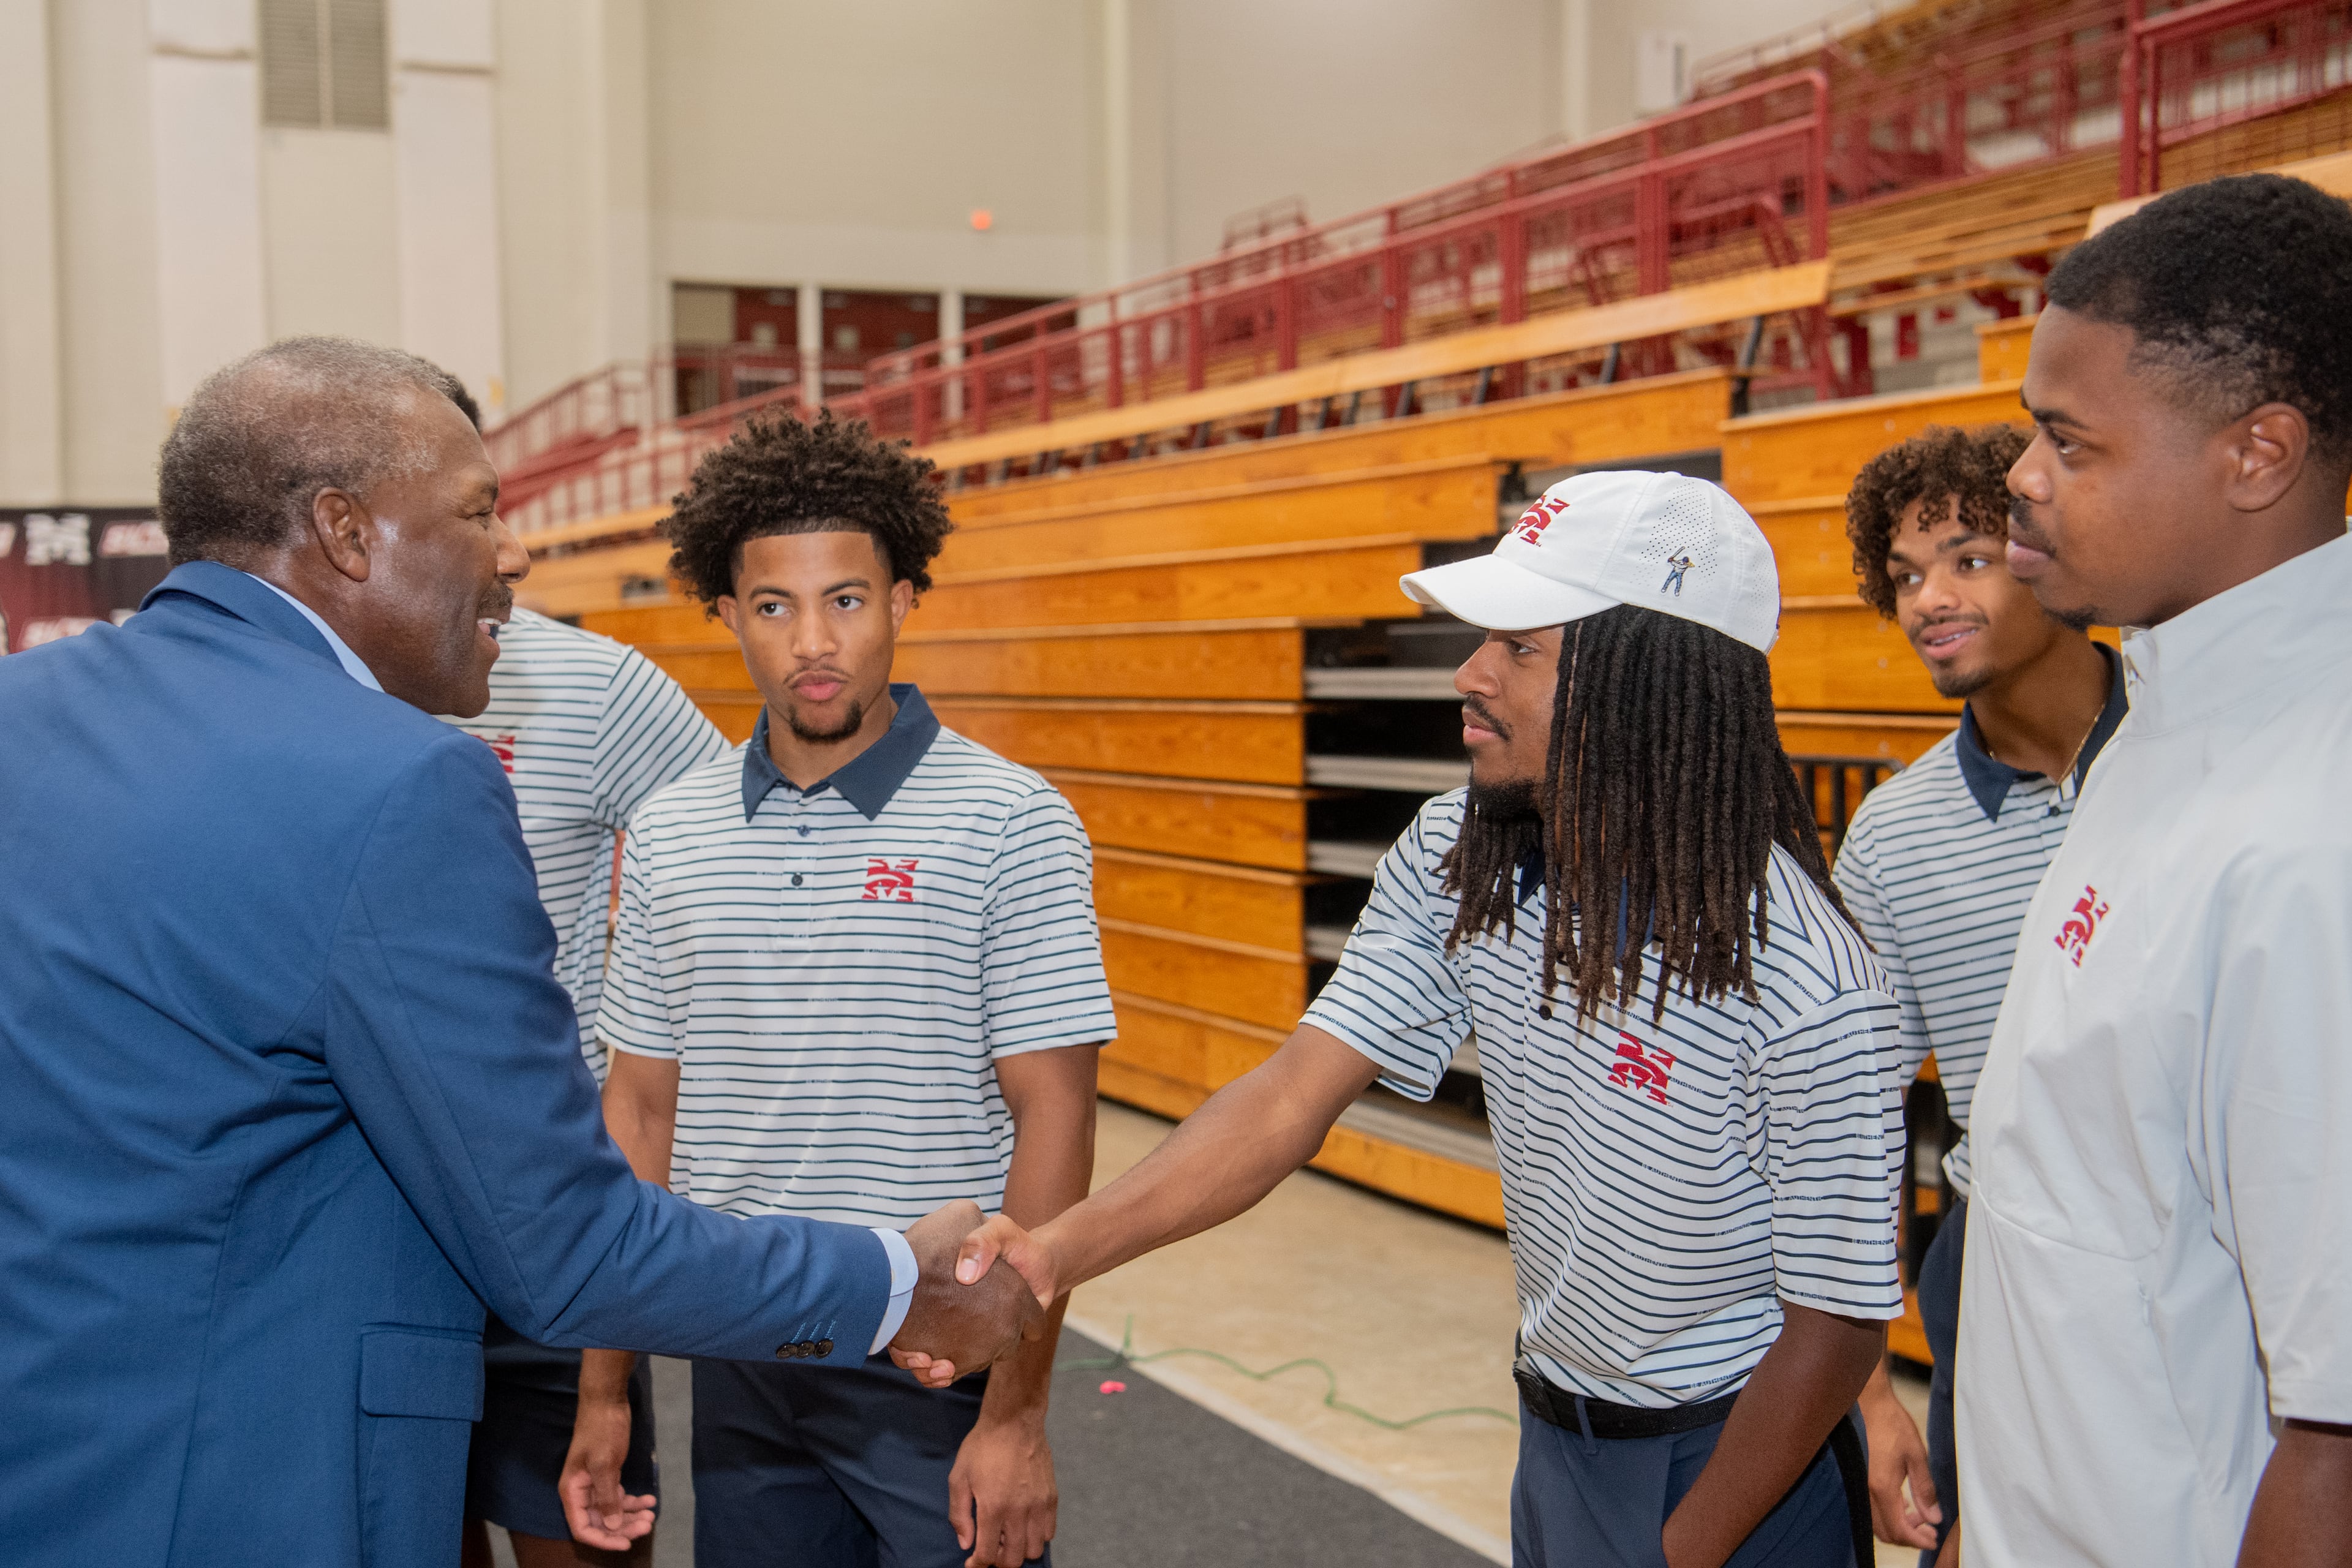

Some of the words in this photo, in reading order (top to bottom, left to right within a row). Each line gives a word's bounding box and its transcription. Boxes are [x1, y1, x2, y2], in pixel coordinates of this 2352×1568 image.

[1670, 1077, 1702, 1093] AUTHENTIC
[1650, 1167, 1684, 1183] AUTHENTIC
[1633, 1253, 1668, 1268] AUTHENTIC
[1700, 1374, 1735, 1386] AUTHENTIC
